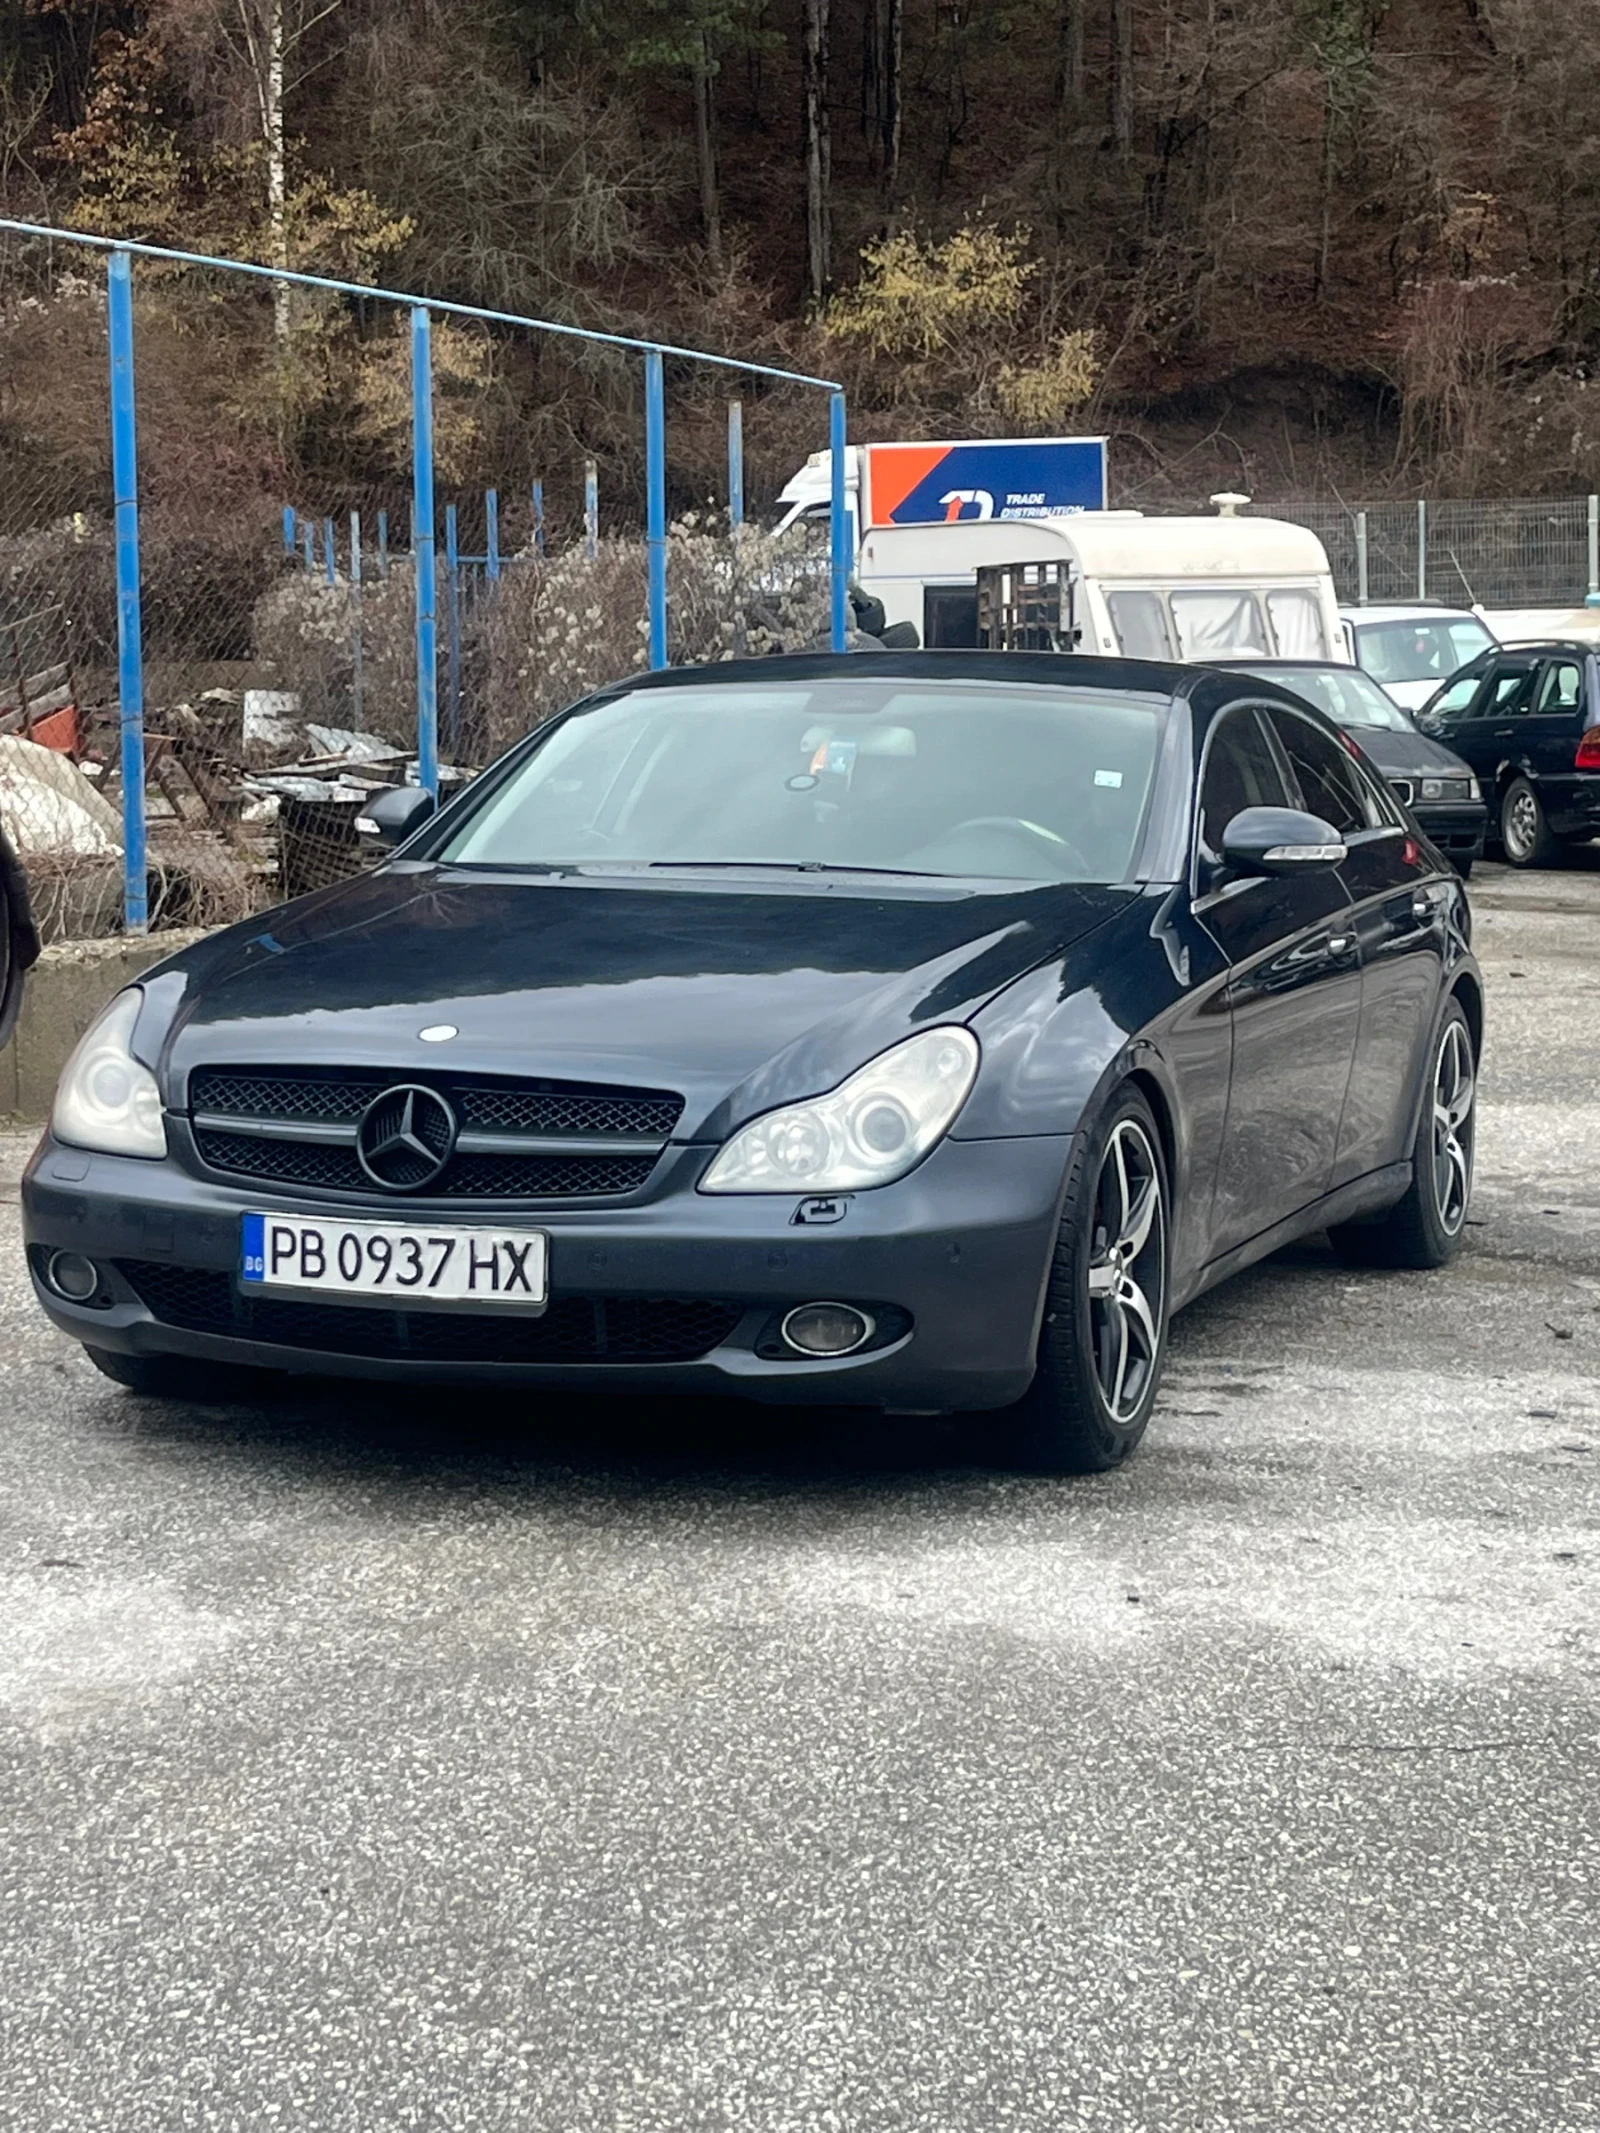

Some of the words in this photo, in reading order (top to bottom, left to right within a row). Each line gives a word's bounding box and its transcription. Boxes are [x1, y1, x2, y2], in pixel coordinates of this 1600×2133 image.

[1006, 493, 1046, 505] TRADE
[245, 1255, 263, 1272] BG
[272, 1226, 326, 1279] PB
[338, 1232, 456, 1288] 0937
[468, 1239, 533, 1292] HX
